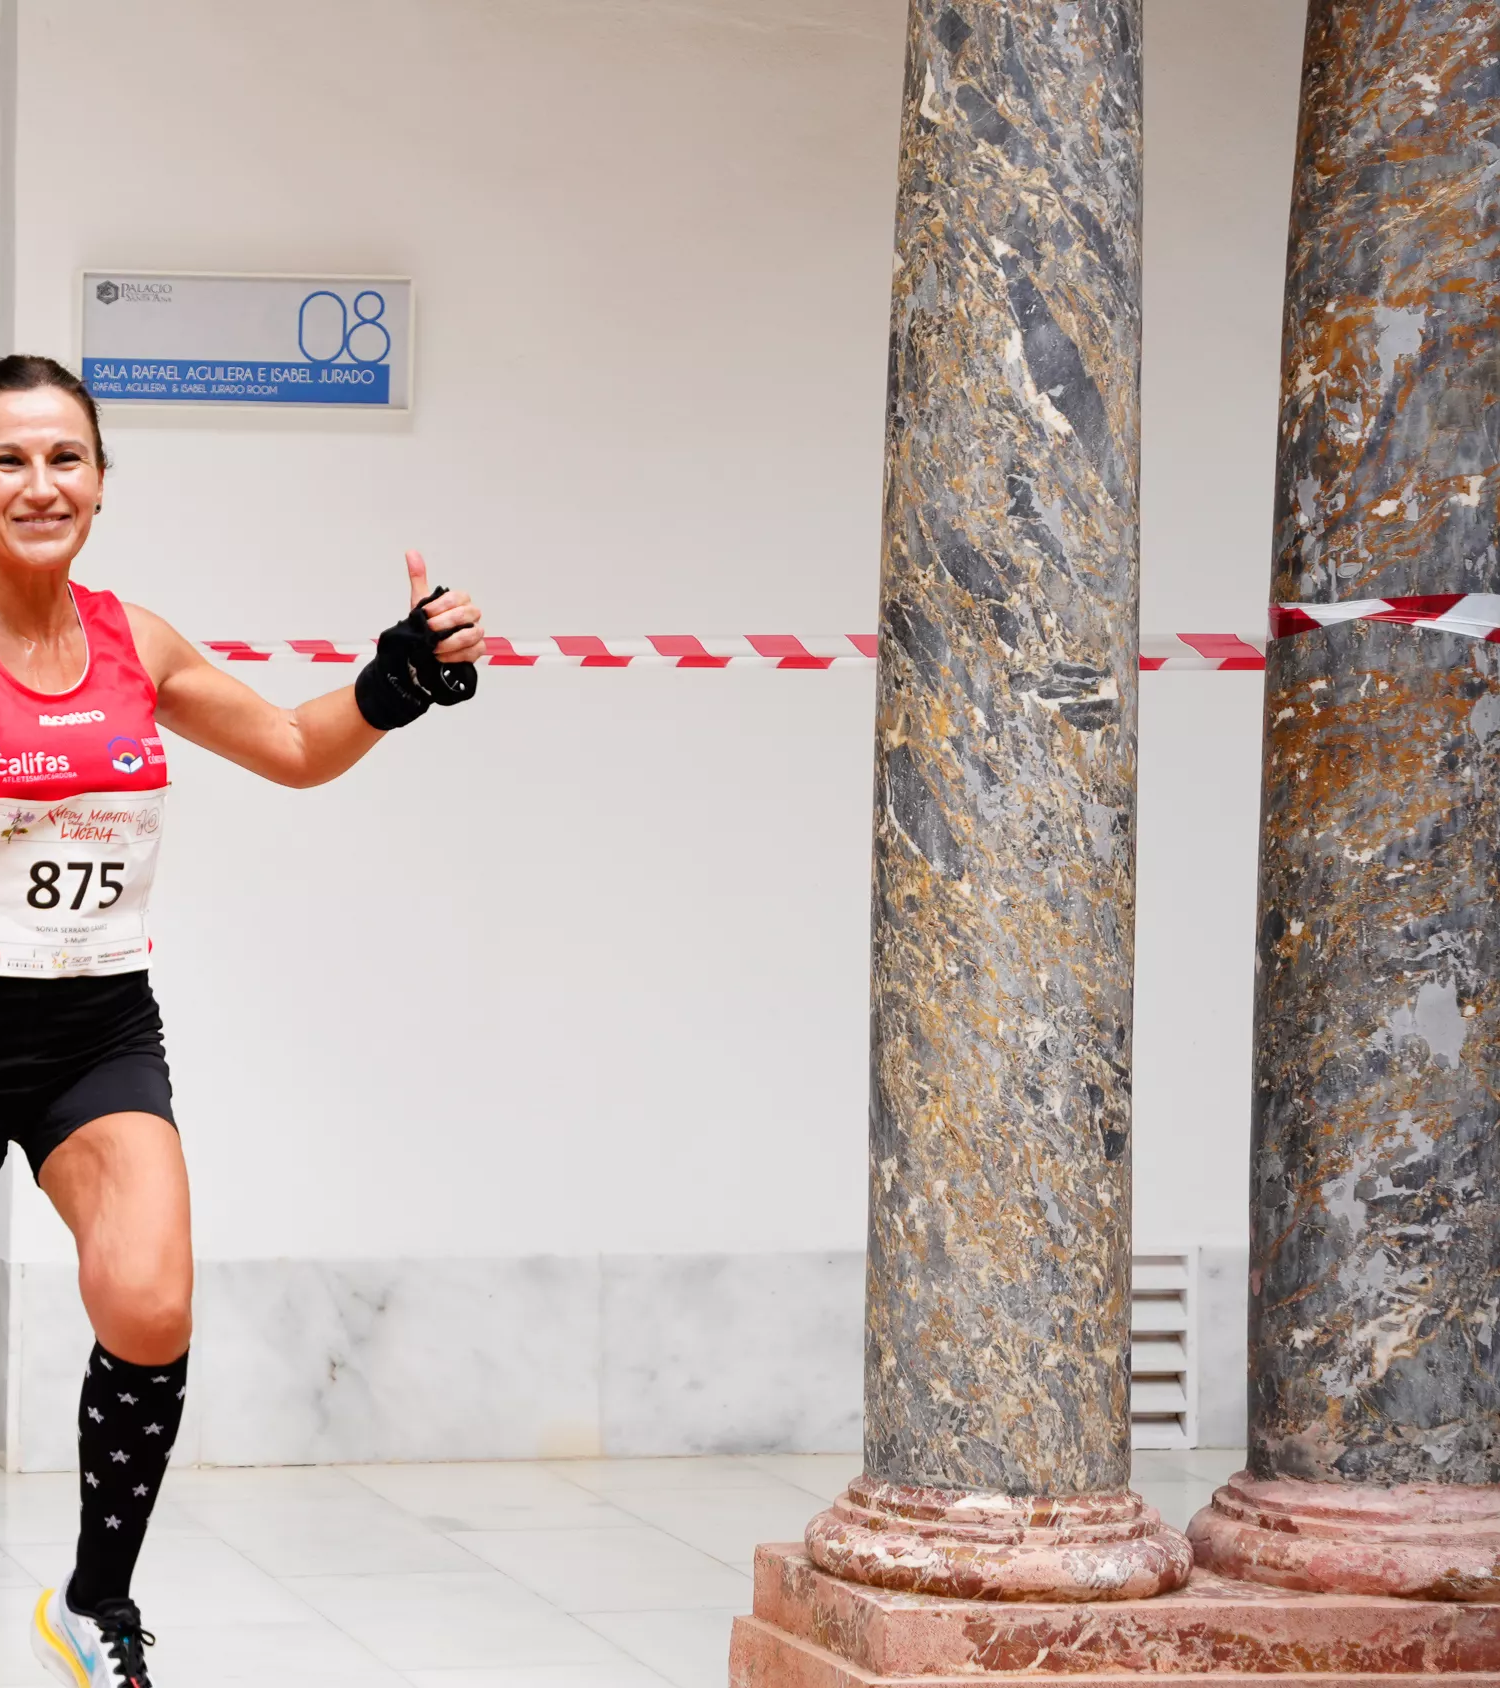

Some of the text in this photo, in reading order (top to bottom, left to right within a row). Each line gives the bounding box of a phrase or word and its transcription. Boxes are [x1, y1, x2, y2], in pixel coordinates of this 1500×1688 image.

[121, 283, 173, 298] PALACIO
[299, 290, 391, 364] 08
[93, 363, 375, 384] SALA RAFAEL AGUILERA E ISABEL JURADO
[93, 382, 278, 395] RAFAEL AGUILERA & ISABEL JURADO ROOM
[60, 821, 121, 842] LUCENA
[27, 861, 125, 910] 875
